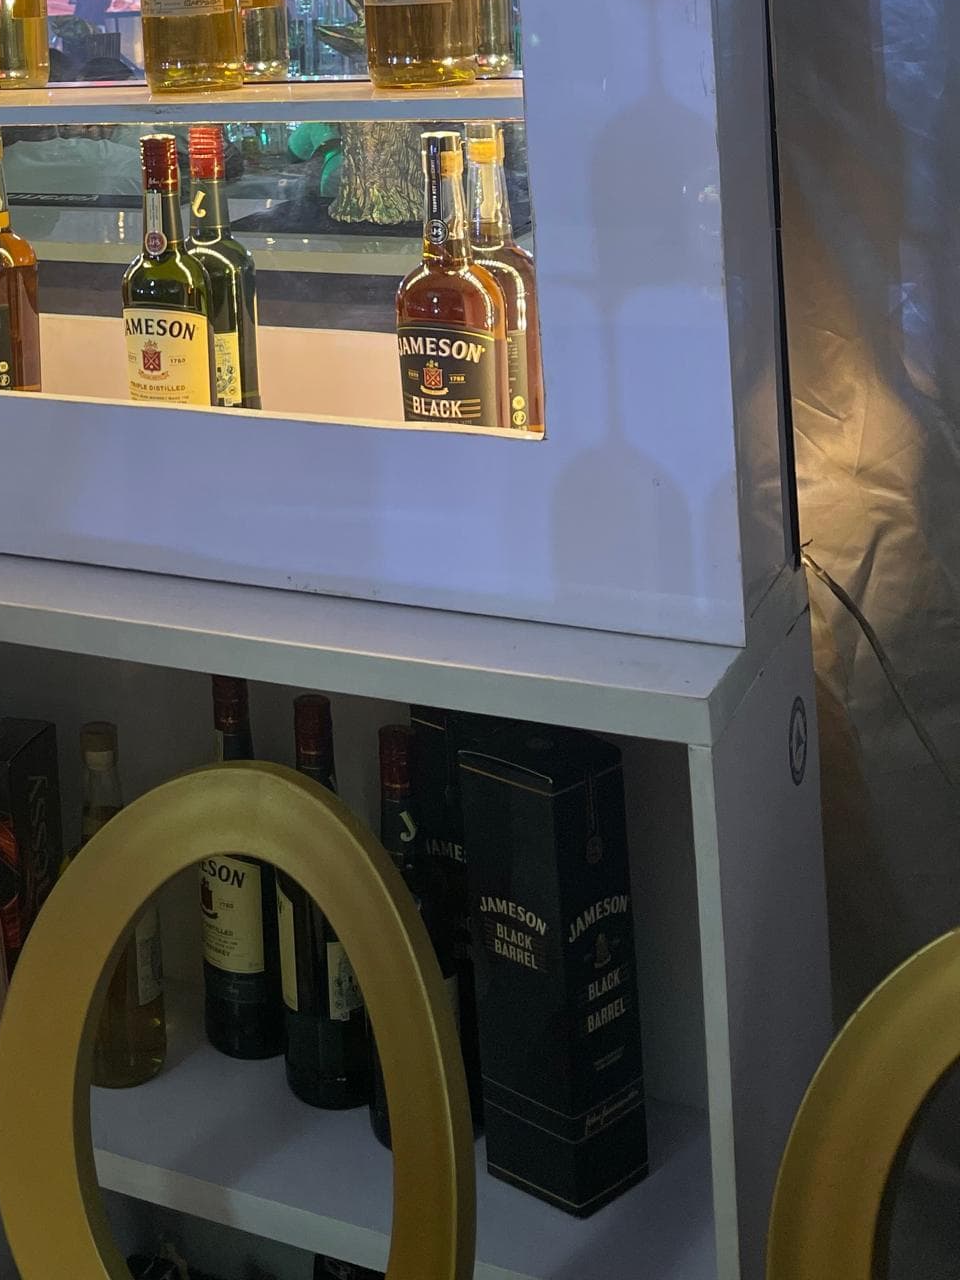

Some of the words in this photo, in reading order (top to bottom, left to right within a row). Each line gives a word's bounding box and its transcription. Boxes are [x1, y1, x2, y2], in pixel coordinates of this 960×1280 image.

[125, 317, 197, 341] AMESON
[149, 382, 186, 392] DISTILLED
[412, 395, 463, 419] BLACK
[399, 810, 417, 842] J
[479, 896, 547, 936] JAMESON
[568, 894, 628, 944] JAMESON
[496, 922, 534, 951] BLACK
[494, 939, 538, 970] BARREL
[588, 969, 622, 1002] BLACK
[586, 997, 627, 1034] BARREL
